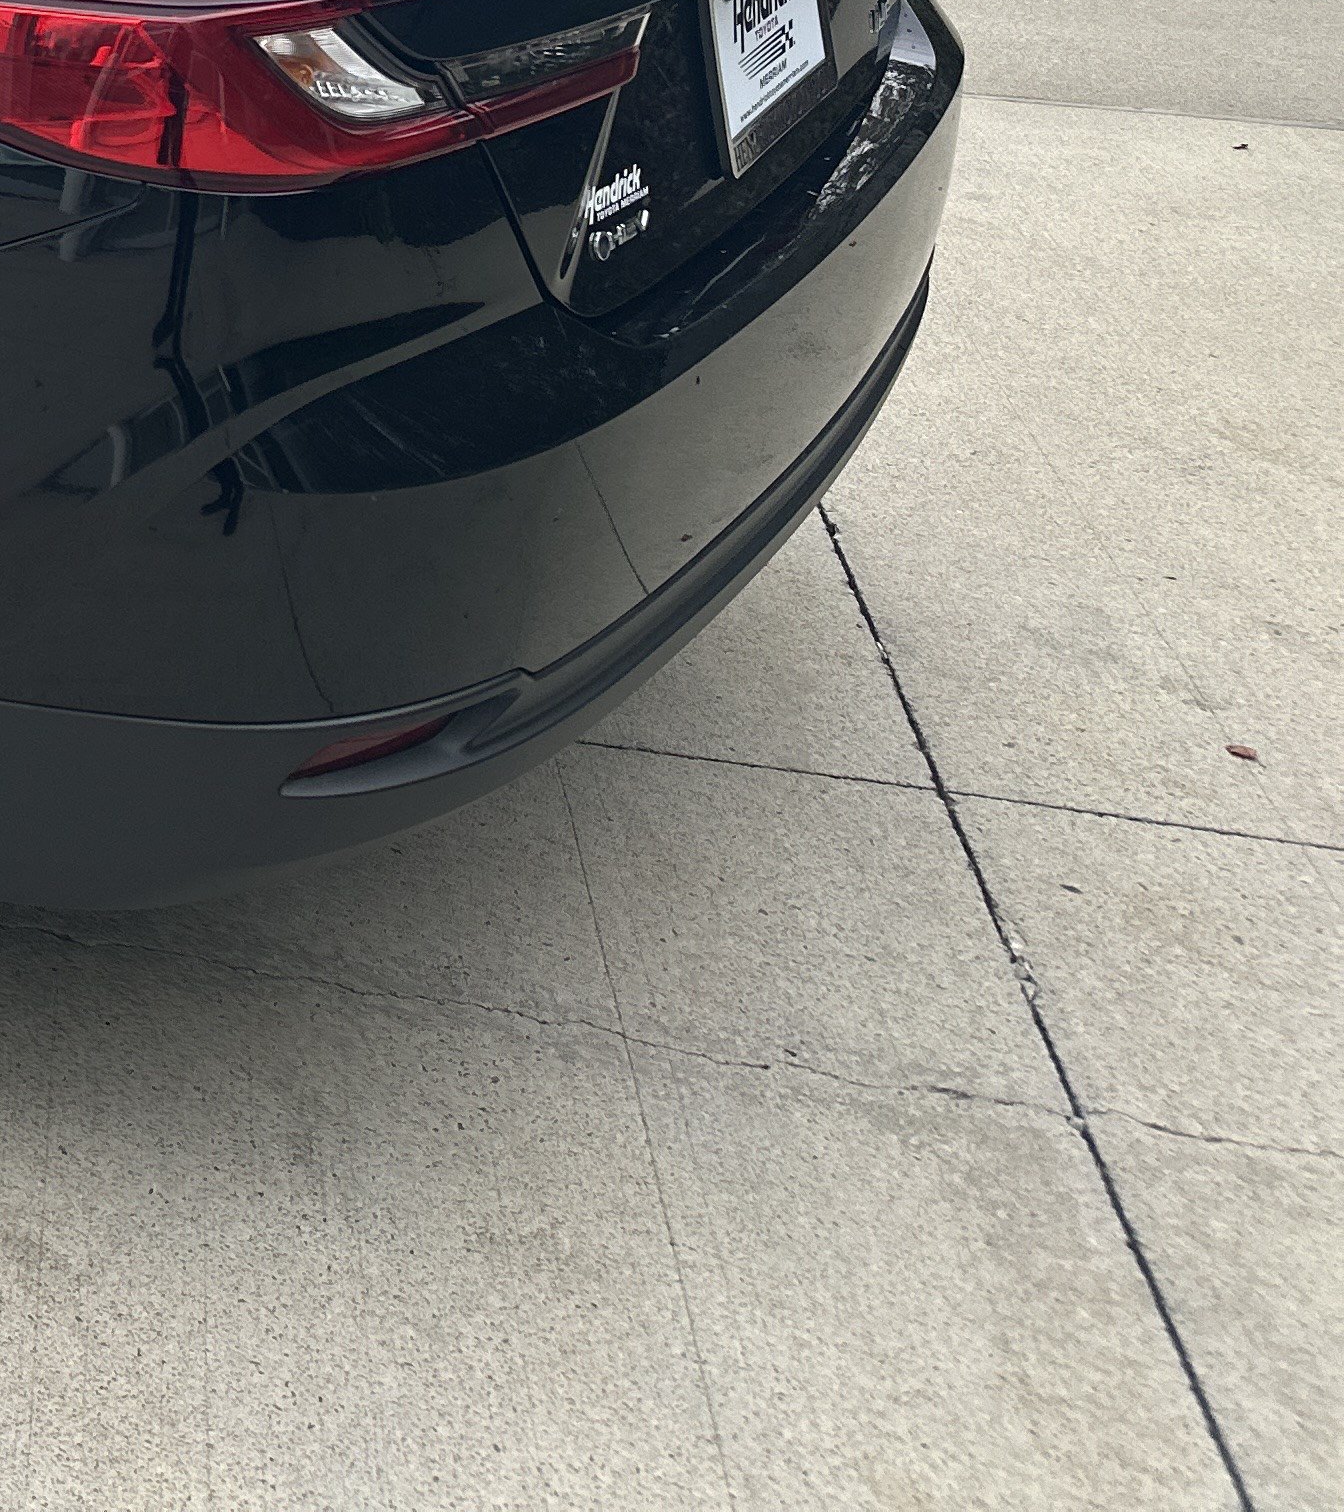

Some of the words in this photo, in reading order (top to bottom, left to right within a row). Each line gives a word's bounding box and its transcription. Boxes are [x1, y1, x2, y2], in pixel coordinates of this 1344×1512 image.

[754, 15, 779, 42] TOYOTA
[759, 58, 788, 89] MERRIAM
[583, 163, 642, 226] Hendrick
[596, 202, 620, 222] TOYOTA
[620, 185, 649, 209] MERRIAM
